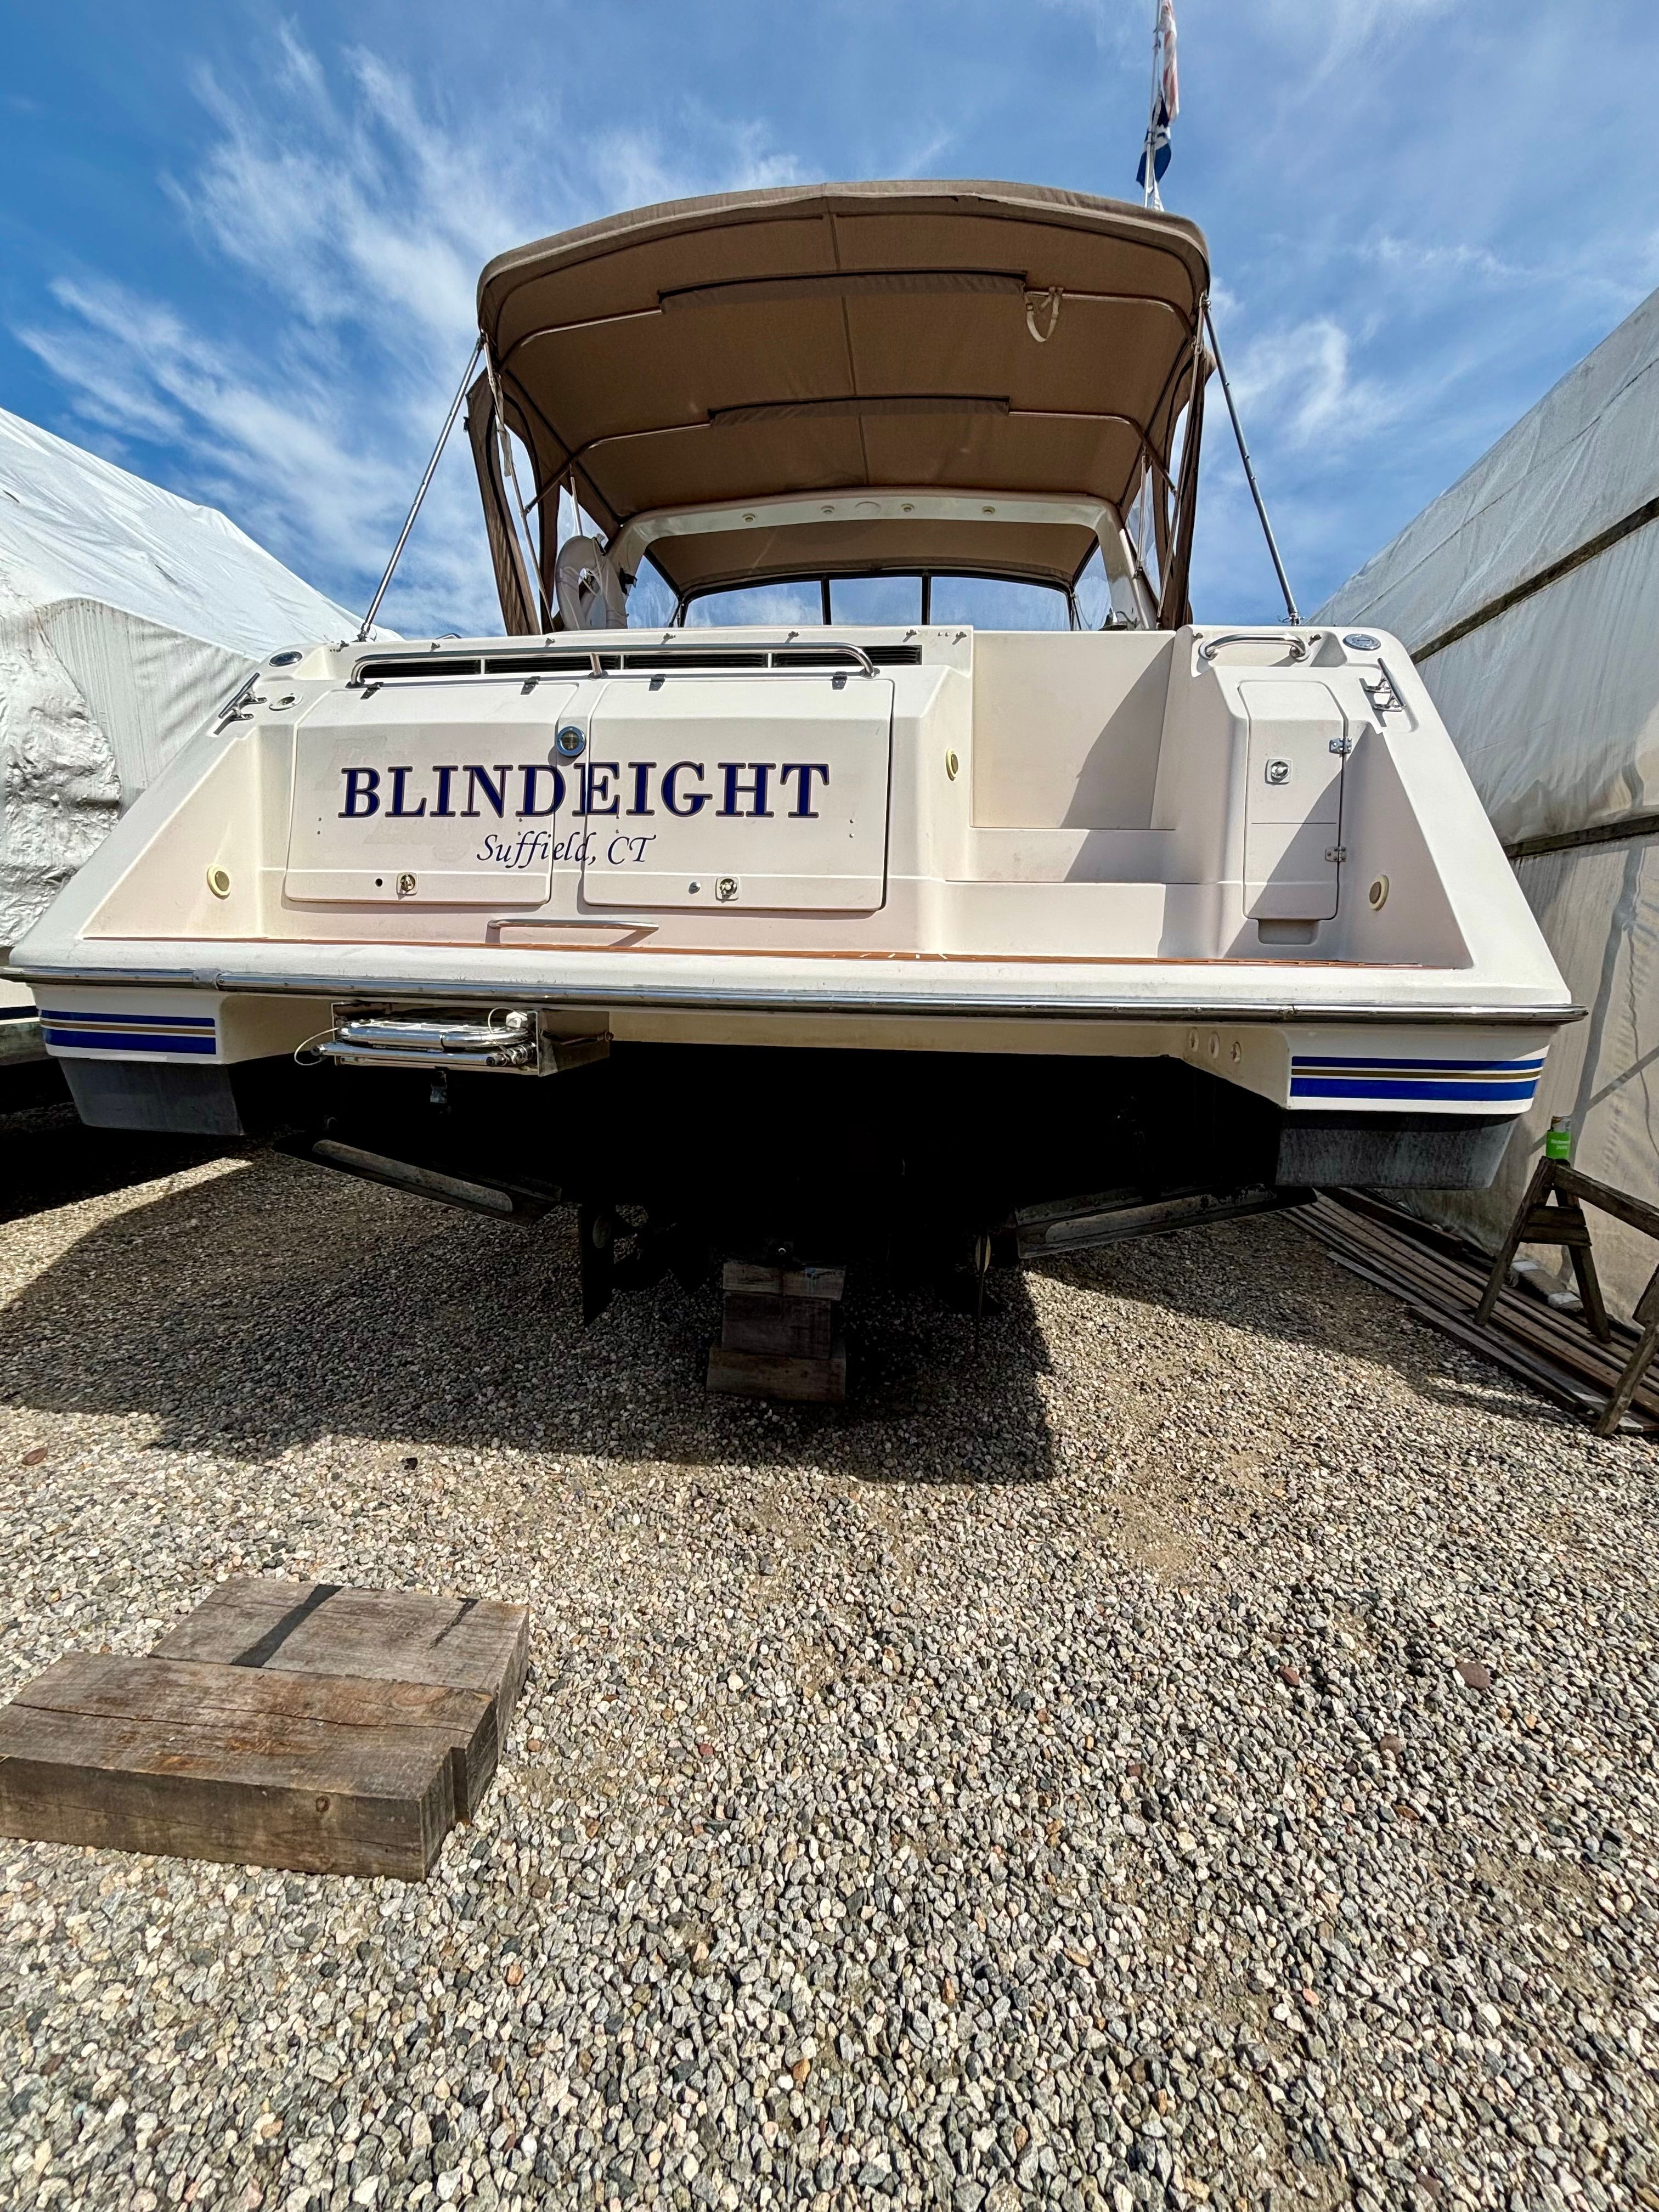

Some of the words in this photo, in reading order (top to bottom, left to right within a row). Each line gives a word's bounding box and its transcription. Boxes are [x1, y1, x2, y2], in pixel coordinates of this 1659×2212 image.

[337, 761, 830, 819] BLINDEIGHT
[476, 831, 597, 868] Suffield,
[607, 834, 657, 865] CT
